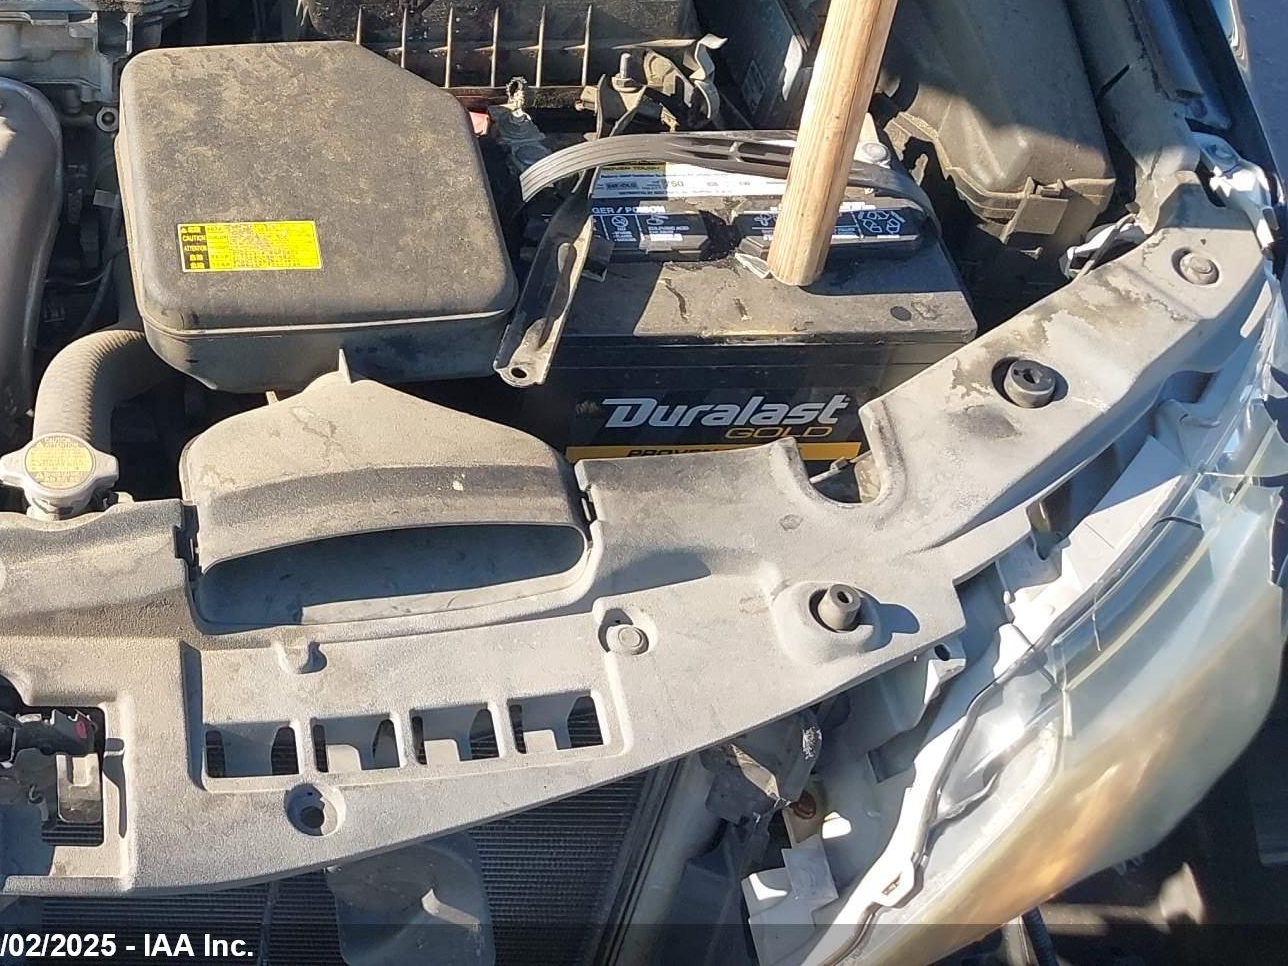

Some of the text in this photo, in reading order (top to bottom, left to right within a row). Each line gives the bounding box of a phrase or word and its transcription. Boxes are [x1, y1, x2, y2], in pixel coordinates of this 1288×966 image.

[182, 234, 206, 242] CAUTION
[602, 395, 850, 428] Duralast
[724, 426, 833, 439] GOLD
